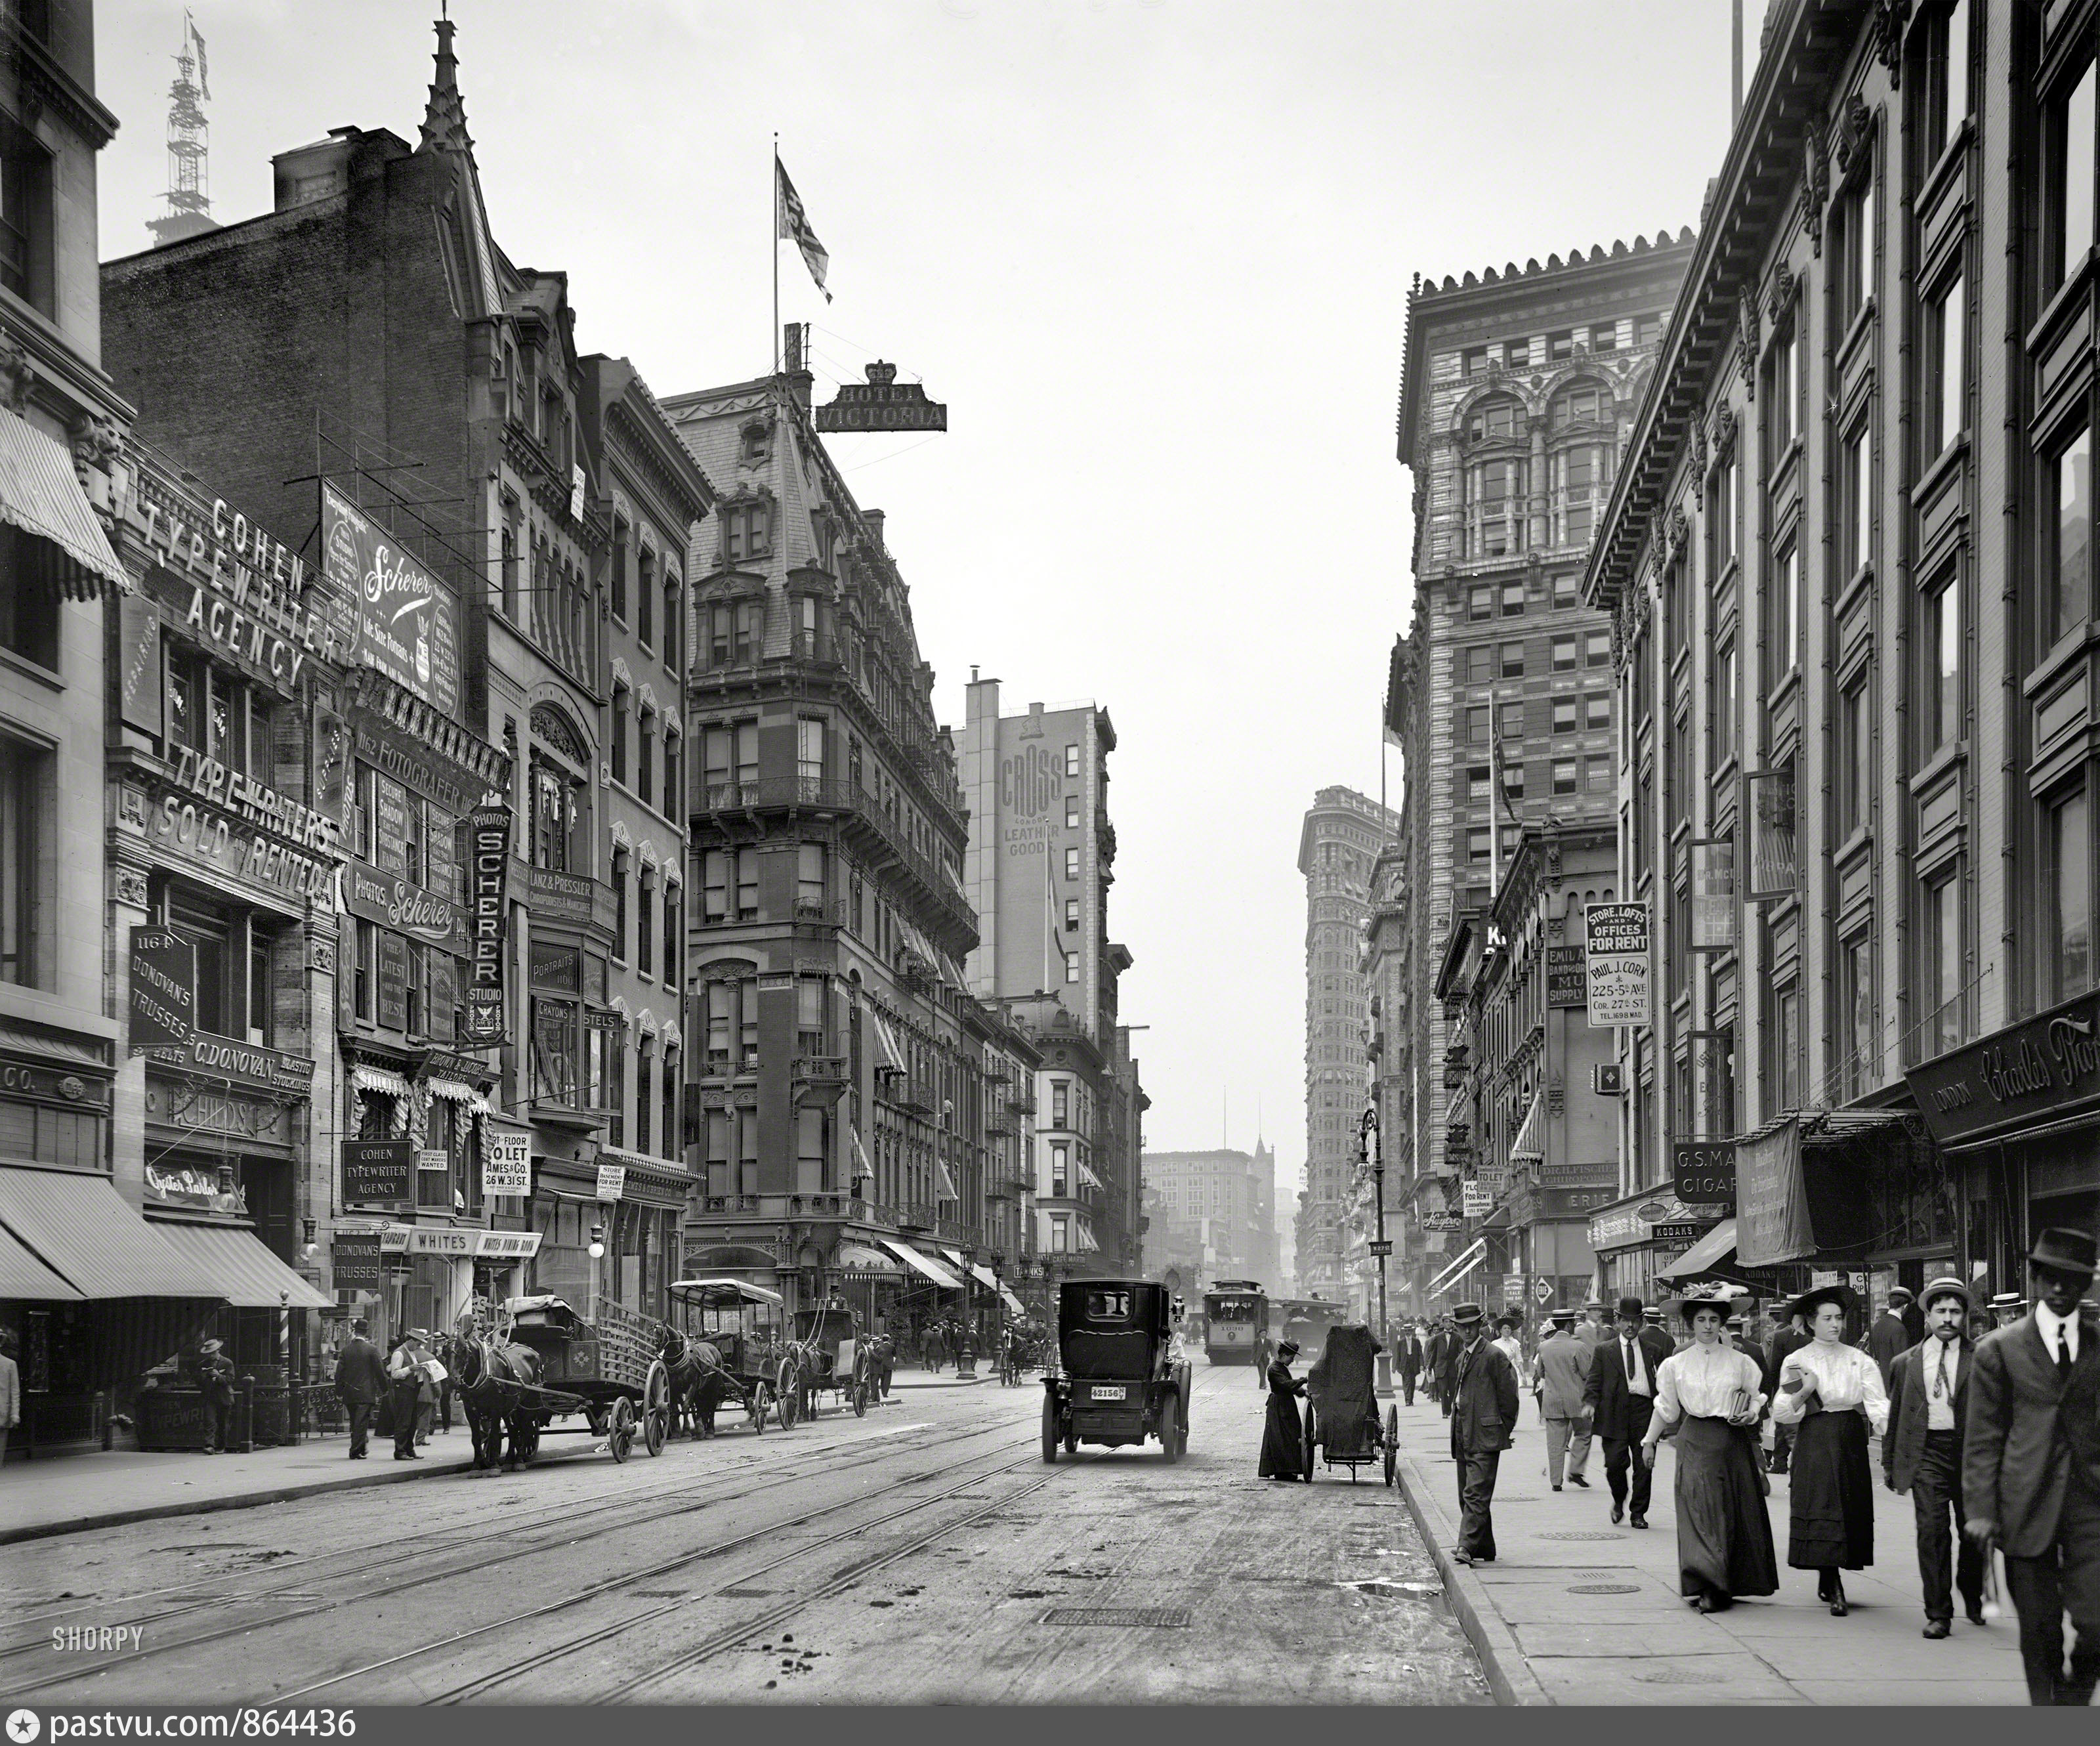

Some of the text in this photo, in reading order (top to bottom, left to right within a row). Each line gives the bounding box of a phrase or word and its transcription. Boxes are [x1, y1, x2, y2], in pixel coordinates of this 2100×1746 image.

[842, 387, 919, 402] HOTEL
[817, 407, 945, 427] VICTORIA
[213, 498, 303, 595] COHEN
[145, 501, 335, 664] TYPEWRITER
[364, 545, 433, 605] Scherer
[186, 588, 304, 687] AGENCY
[316, 729, 340, 799] SUPPLIES
[360, 731, 377, 756] 1162
[378, 740, 460, 805] FOTOGRAFER
[1002, 744, 1062, 818] CROSS
[381, 778, 401, 803] SECURE
[379, 797, 403, 828] SHADOW
[472, 813, 510, 828] PHOTOS
[158, 796, 322, 898] SOLD RENTED
[379, 828, 404, 857] SUBSTANCE
[430, 826, 452, 853] SHADOW
[382, 849, 402, 874] FADES
[429, 854, 452, 880] SUBSTANCE
[432, 874, 450, 897] FADES
[530, 870, 547, 888] LANZ
[548, 877, 554, 889] &
[388, 881, 453, 932] Scherer
[474, 832, 504, 981] SCHERER
[1588, 906, 1647, 926] STORE, LOFTS
[1594, 924, 1641, 937] OFFICES
[137, 937, 171, 949] 1164
[386, 941, 398, 956] THE
[1589, 935, 1647, 952] FOR RENT
[1549, 948, 1574, 962] EMIL
[380, 953, 405, 983] LATEST
[533, 954, 574, 981] PORTRAITS
[1591, 961, 1647, 981] PAUL J. CORN
[132, 955, 191, 1007] DONOVAN'S
[557, 974, 573, 986] 1160
[1630, 983, 1647, 995] AVE
[469, 988, 502, 1002] STUDIO
[1549, 987, 1585, 1002] SUPPLY
[1631, 998, 1647, 1008] ST.
[131, 987, 188, 1039] TRUSSES
[539, 1002, 568, 1019] CRAYONS
[583, 1013, 615, 1027] STELS
[430, 1054, 485, 1076] BROWN & JACOBS
[1979, 1038, 2051, 1101] Charles
[4, 1067, 35, 1090] CO.
[271, 1073, 311, 1092] STOCKINGS
[436, 1069, 468, 1084] TAILORS
[182, 1094, 247, 1134] CHILDS
[505, 1137, 527, 1145] FLOOR
[361, 1149, 392, 1160] COHEN
[493, 1147, 528, 1161] O LET
[346, 1165, 407, 1178] TYPEWRITER
[486, 1161, 509, 1174] AMES
[514, 1162, 528, 1174] CO.
[146, 1165, 185, 1199] Oyster
[486, 1175, 497, 1185] 26
[497, 1176, 507, 1185] W.
[516, 1176, 527, 1186] ST.
[1479, 1173, 1503, 1182] TO LET
[358, 1183, 396, 1195] AGENCY
[1476, 1192, 1490, 1201] RENT
[1570, 1194, 1610, 1208] ERIE
[1656, 1225, 1692, 1237] KODAKS
[418, 1233, 467, 1248] WHITE'S
[335, 1244, 379, 1257] DONOVAN'S
[335, 1266, 378, 1279] TRUSSES
[1016, 1267, 1043, 1276] TNKS
[1091, 1388, 1118, 1399] 42156
